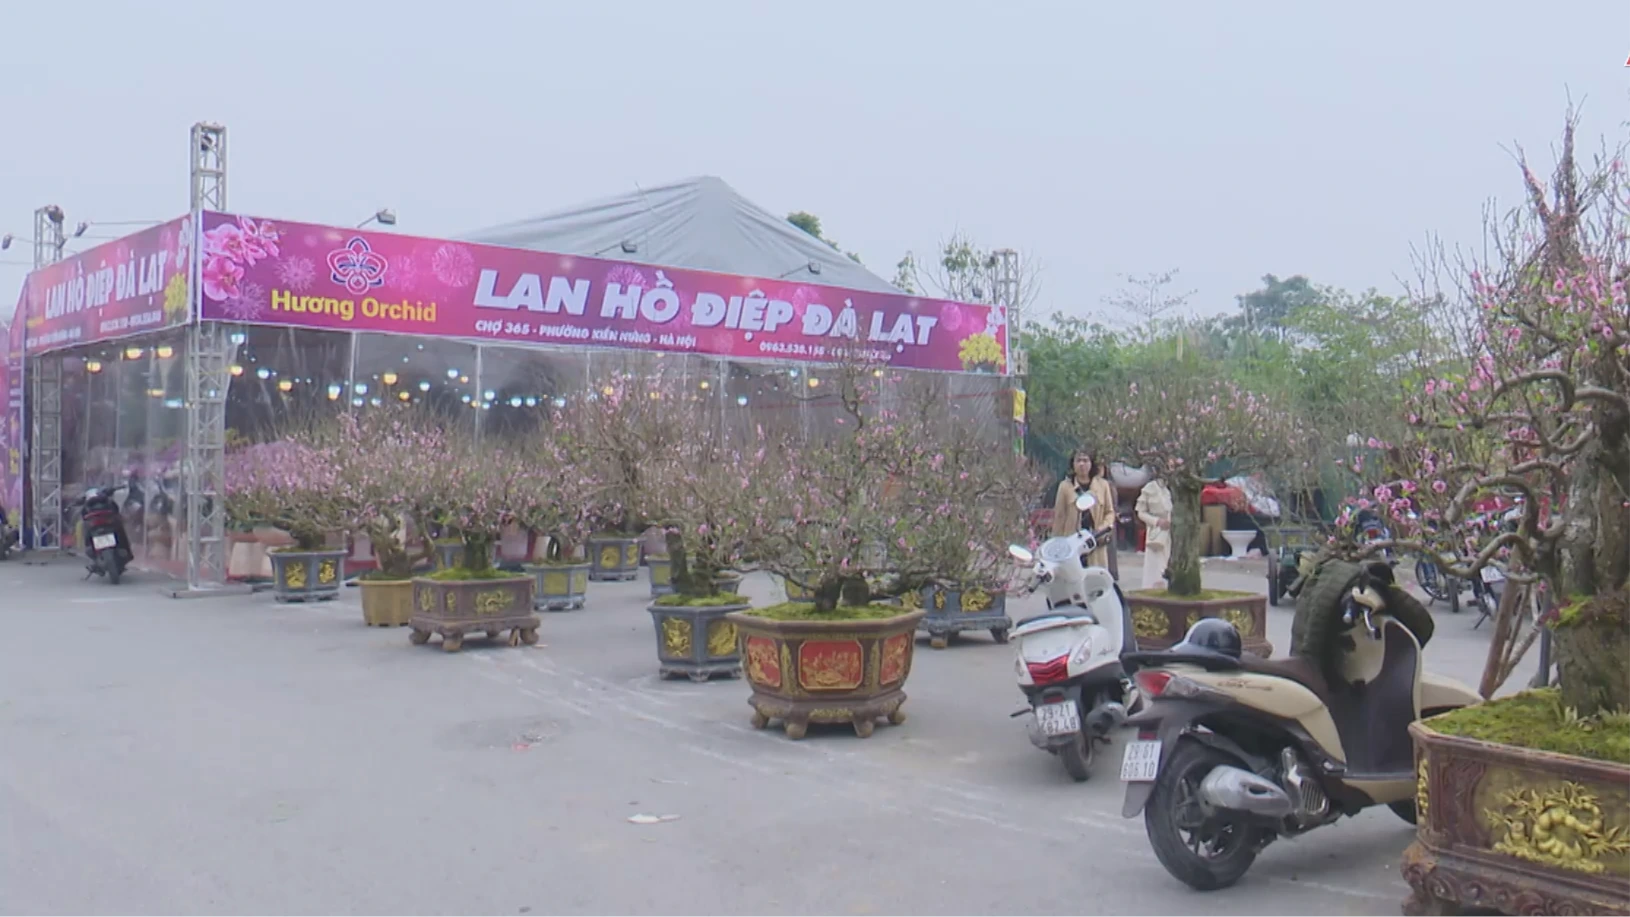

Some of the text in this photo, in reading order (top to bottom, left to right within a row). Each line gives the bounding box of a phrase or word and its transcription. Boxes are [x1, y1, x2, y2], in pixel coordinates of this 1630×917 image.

[45, 281, 65, 319] LAN
[139, 250, 168, 306] LẠT
[271, 289, 437, 322] Hương Orchid
[473, 268, 938, 354] LAN HỒ ĐIỆP ĐÀ LẠT
[475, 319, 504, 336] CHỢ
[505, 322, 530, 336] 365
